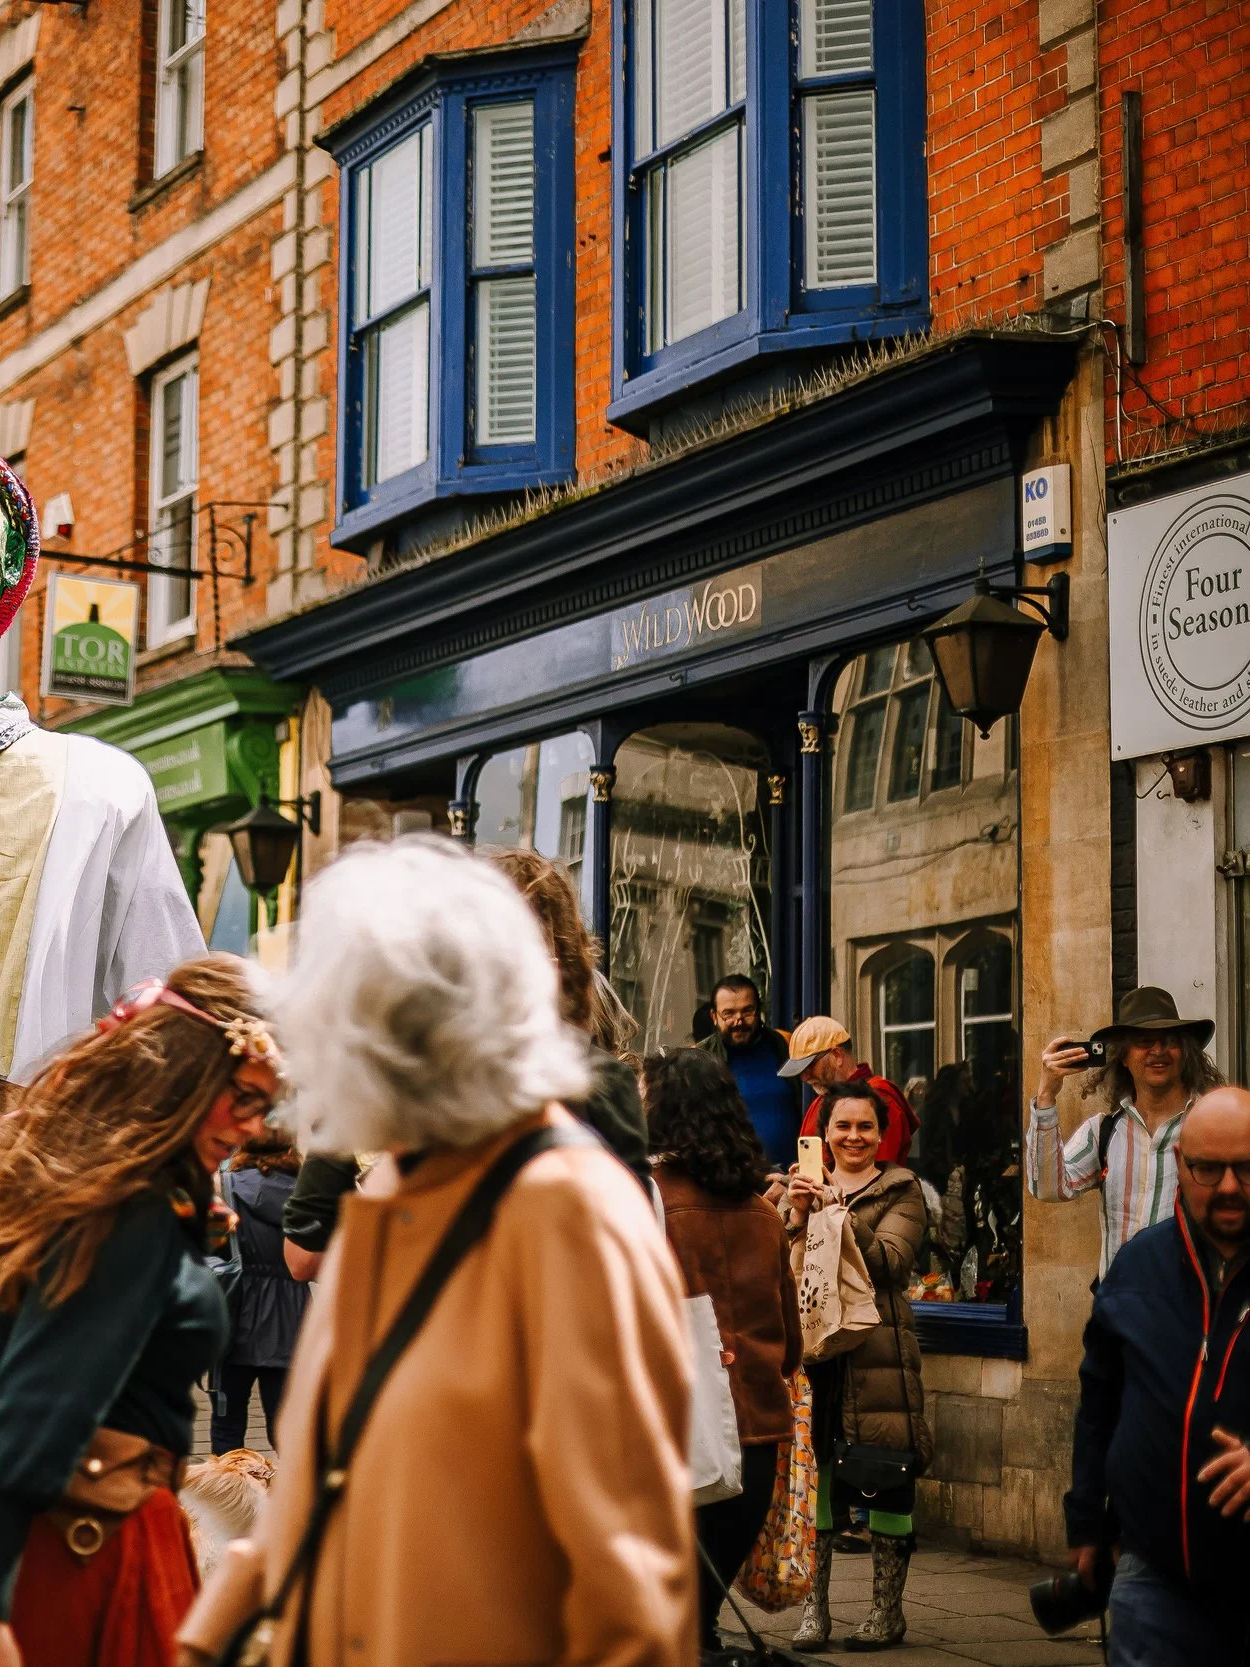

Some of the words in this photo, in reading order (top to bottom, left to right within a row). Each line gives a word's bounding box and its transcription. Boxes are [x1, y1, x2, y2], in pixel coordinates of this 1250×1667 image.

[1025, 477, 1048, 503] KO
[1152, 556, 1175, 608] Finest
[1173, 514, 1250, 555] international
[1185, 567, 1243, 601] Four
[619, 579, 756, 662] WILDWOOD
[57, 632, 125, 666] TOR
[1151, 633, 1160, 651] in
[1155, 656, 1178, 696] suede
[1179, 688, 1219, 712] leather
[1222, 683, 1244, 708] and
[821, 1281, 829, 1312] REUSE
